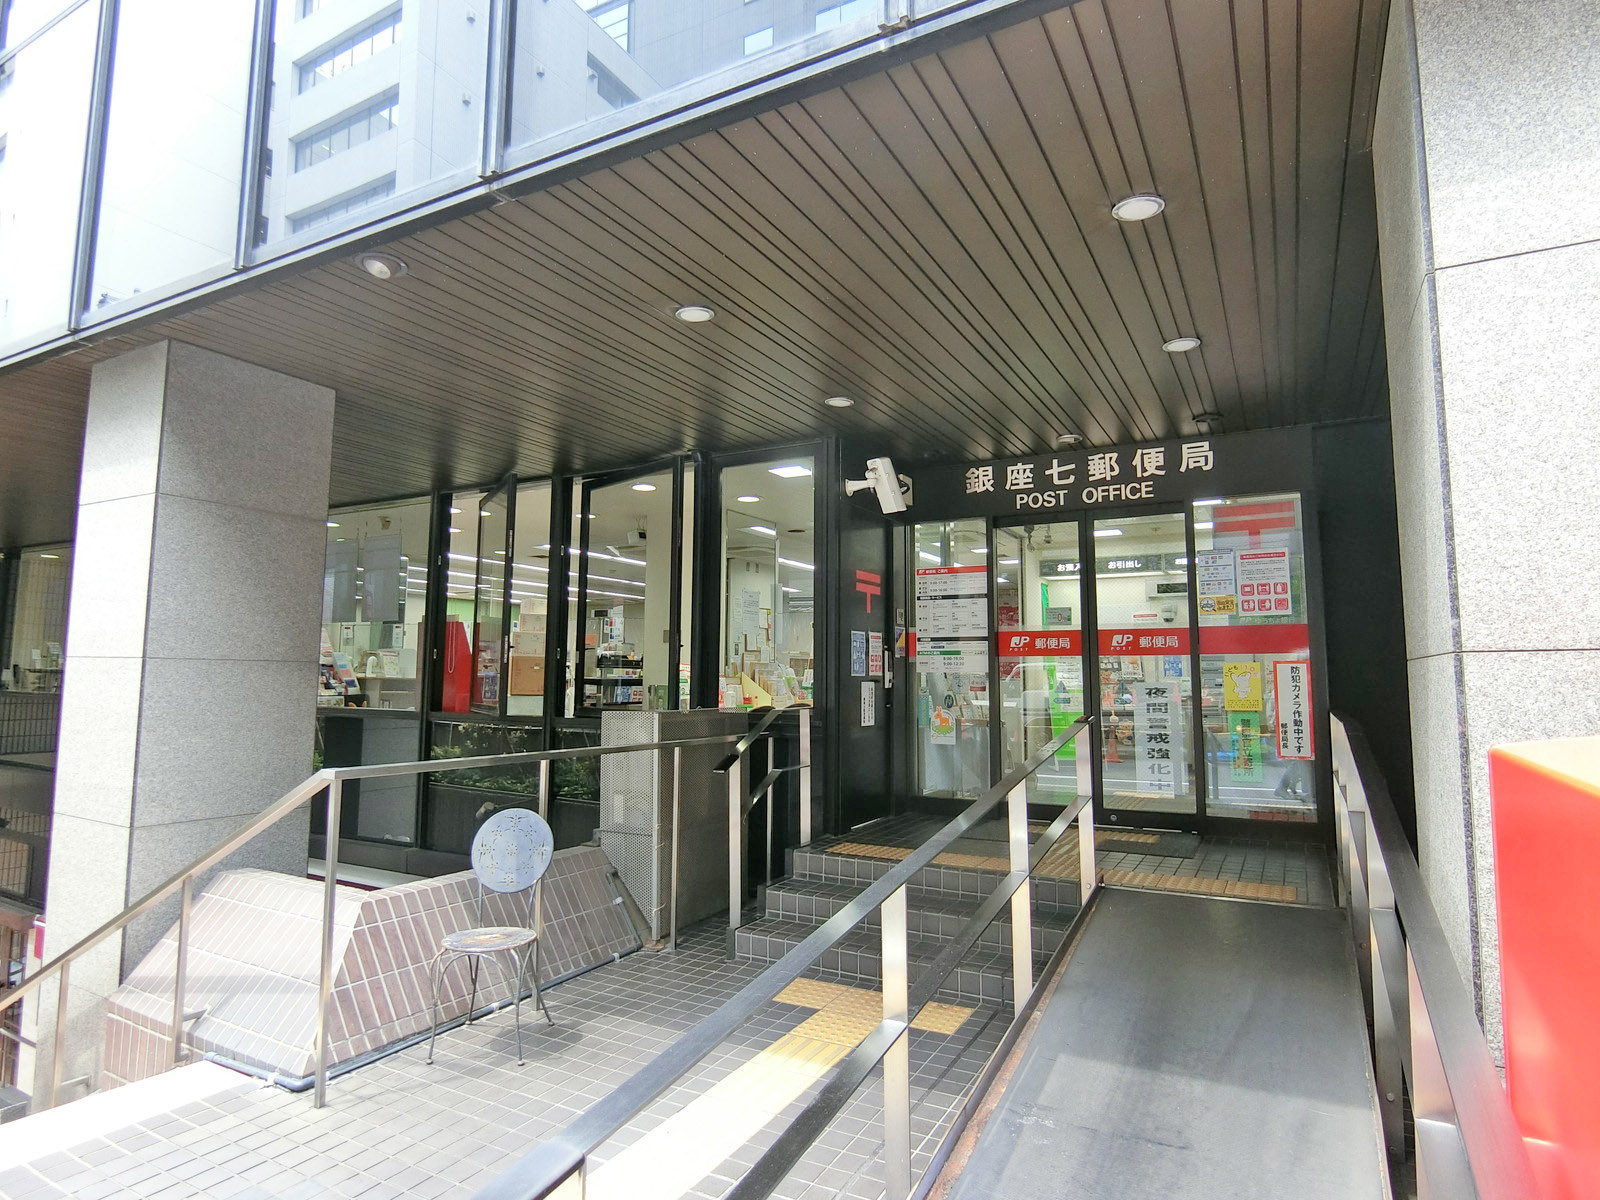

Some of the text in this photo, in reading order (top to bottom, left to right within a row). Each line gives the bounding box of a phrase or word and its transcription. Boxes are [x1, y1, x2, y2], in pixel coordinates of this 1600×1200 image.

[965, 441, 1214, 494] 銀座七郵便局
[1016, 481, 1155, 510] POST OFFICE
[1107, 560, 1142, 569] お引出し
[1034, 637, 1071, 649] 郵便局
[1139, 635, 1179, 648] 郵便局
[1290, 666, 1304, 754] 防犯カメラ作動中です
[1145, 687, 1171, 791] 夜間警戒強化中
[1280, 722, 1289, 750] 郵便局長
